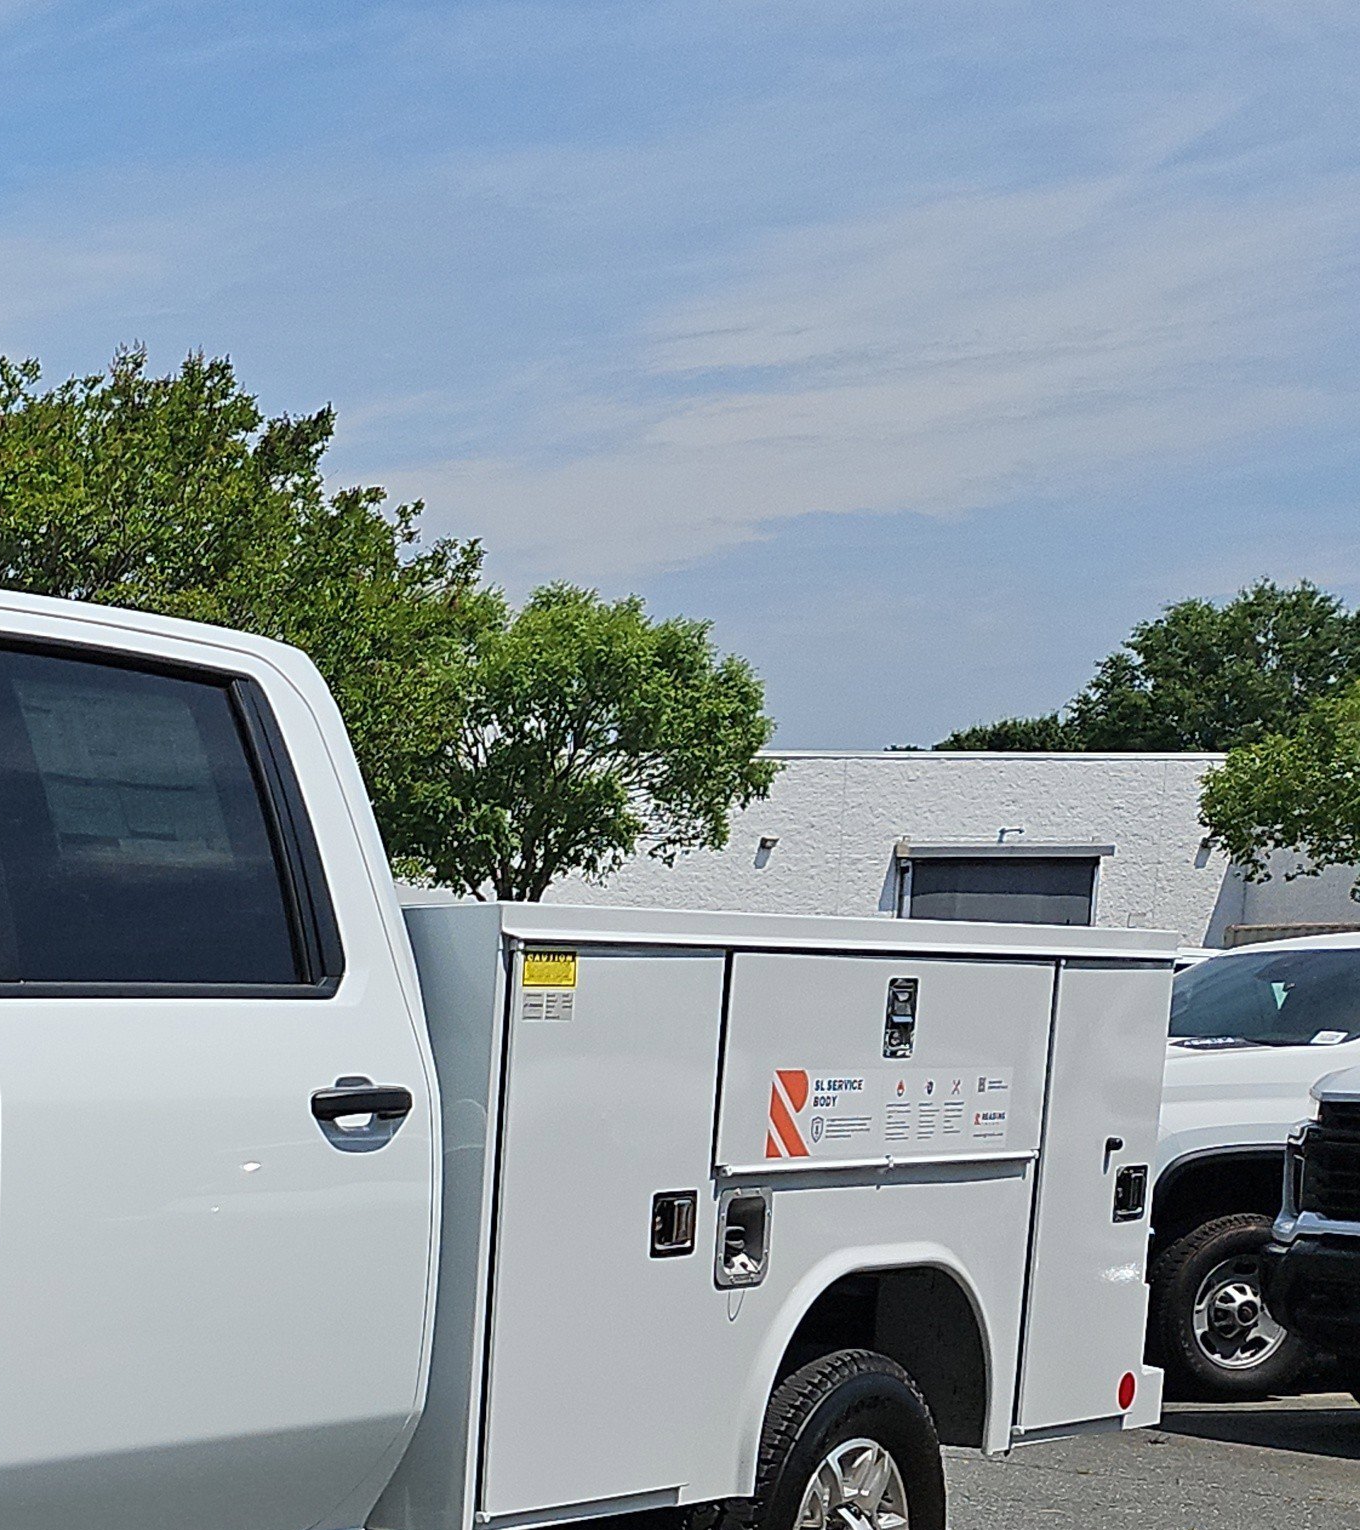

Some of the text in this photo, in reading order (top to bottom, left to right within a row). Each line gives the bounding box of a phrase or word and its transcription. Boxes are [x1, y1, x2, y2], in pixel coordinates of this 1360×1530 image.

[814, 1079, 863, 1091] SL SERVICE
[813, 1096, 838, 1107] BODY
